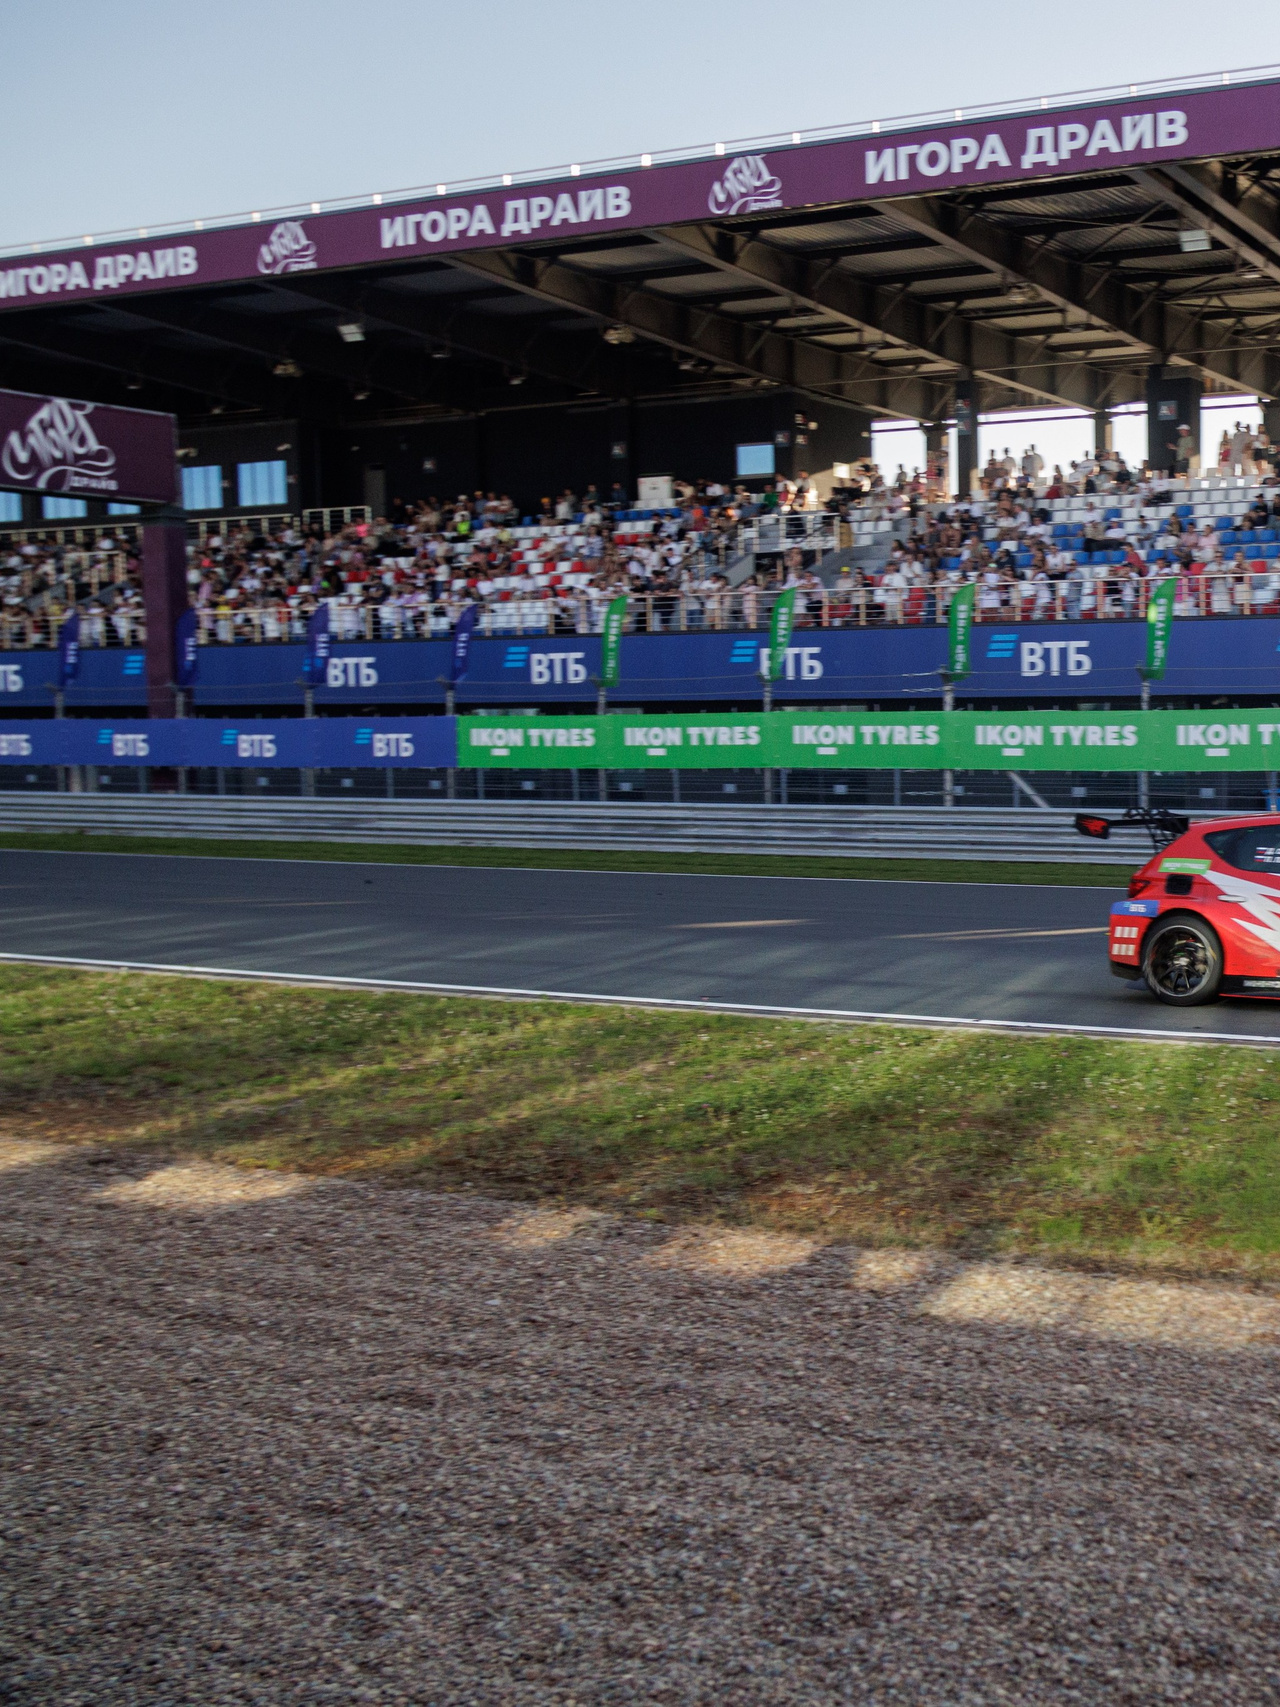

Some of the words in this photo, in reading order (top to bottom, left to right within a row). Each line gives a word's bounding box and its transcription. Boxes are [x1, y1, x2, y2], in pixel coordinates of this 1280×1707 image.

[865, 135, 1009, 184] ИГОРА
[1021, 110, 1188, 169] ДРАЙВ
[380, 204, 496, 248] ИГОРА
[501, 185, 632, 237] ДРАЙВ
[0, 261, 90, 298] ИГОРА
[530, 652, 587, 684] ВТБ
[1020, 641, 1092, 677] ВТБ
[326, 657, 378, 687] ВТБ
[112, 734, 149, 756] ВТБ
[237, 734, 277, 758] ВТБ
[372, 734, 414, 757] ВТБ
[470, 728, 524, 750] IKON
[528, 728, 596, 747] TYRES
[624, 727, 682, 749] IKON
[686, 726, 761, 745] TYRES
[792, 725, 854, 749] IKON
[860, 725, 940, 745] TYRES
[975, 725, 1043, 750] IKON
[1049, 725, 1138, 746] TYRES
[1176, 724, 1250, 750] IKON
